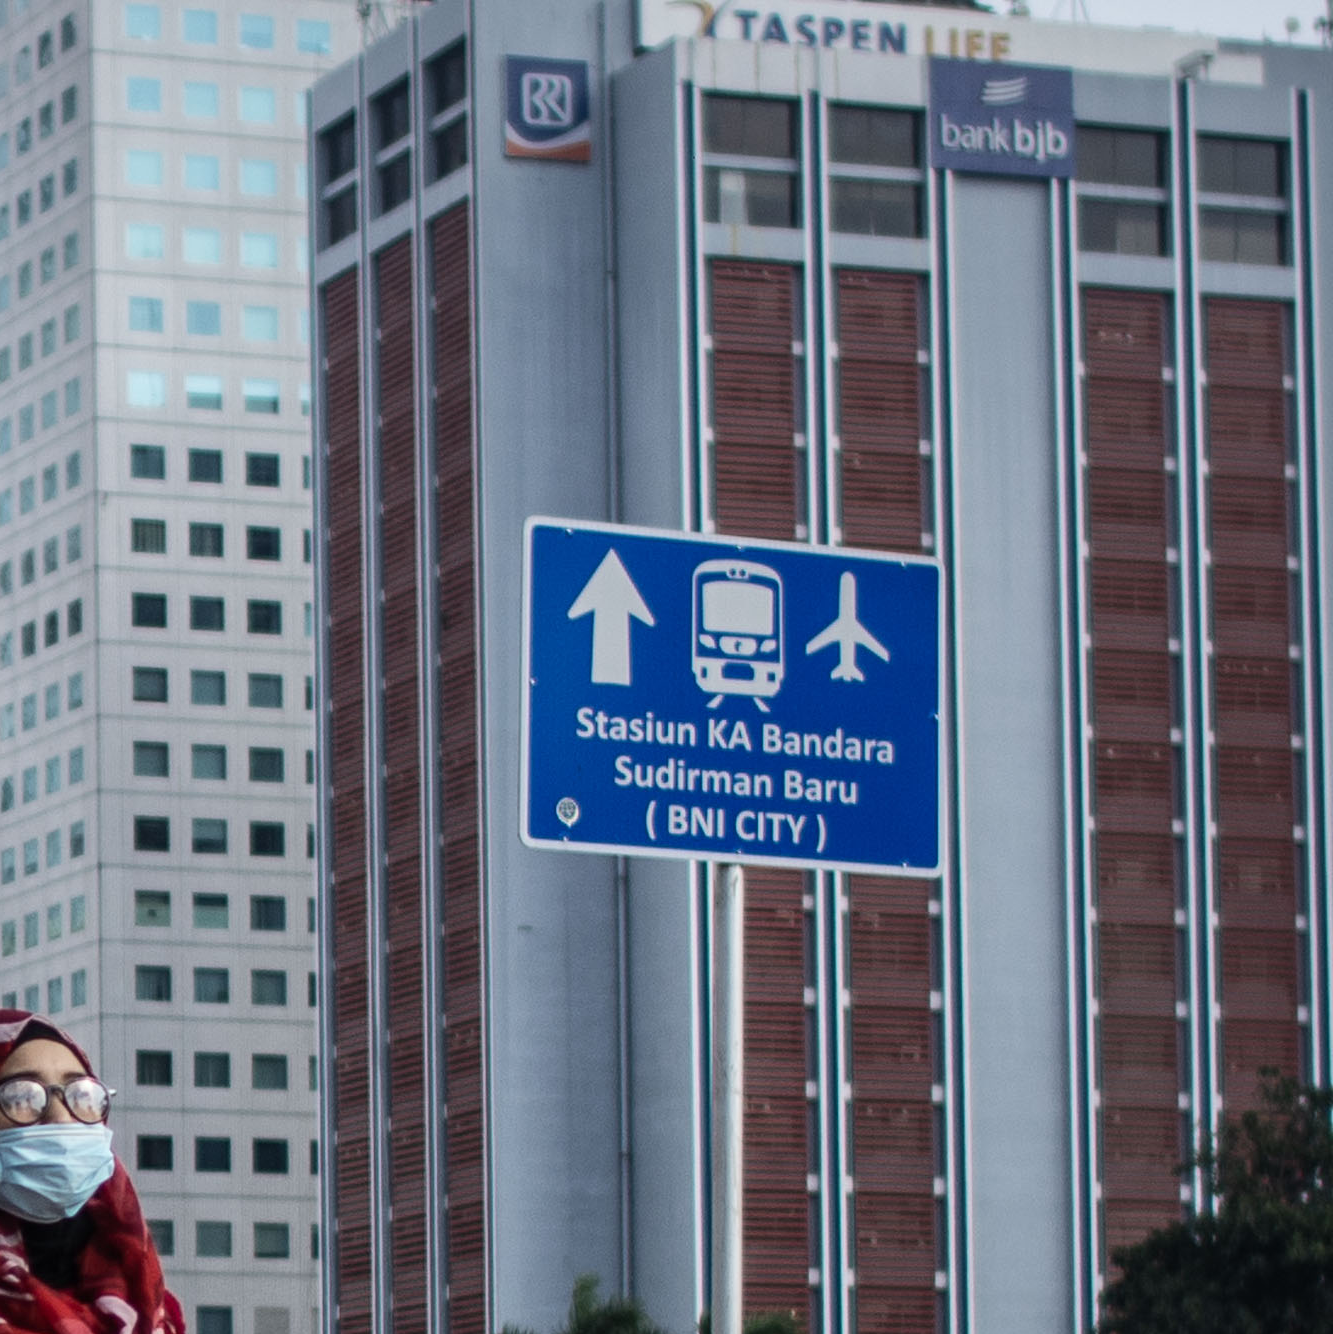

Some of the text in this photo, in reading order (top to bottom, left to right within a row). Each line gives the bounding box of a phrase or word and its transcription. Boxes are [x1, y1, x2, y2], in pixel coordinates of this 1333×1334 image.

[734, 9, 907, 55] TASPEN
[940, 113, 1068, 162] bank bjb
[576, 706, 895, 764] Stasiun KA Bandara
[614, 755, 858, 804] Sudirman Baru
